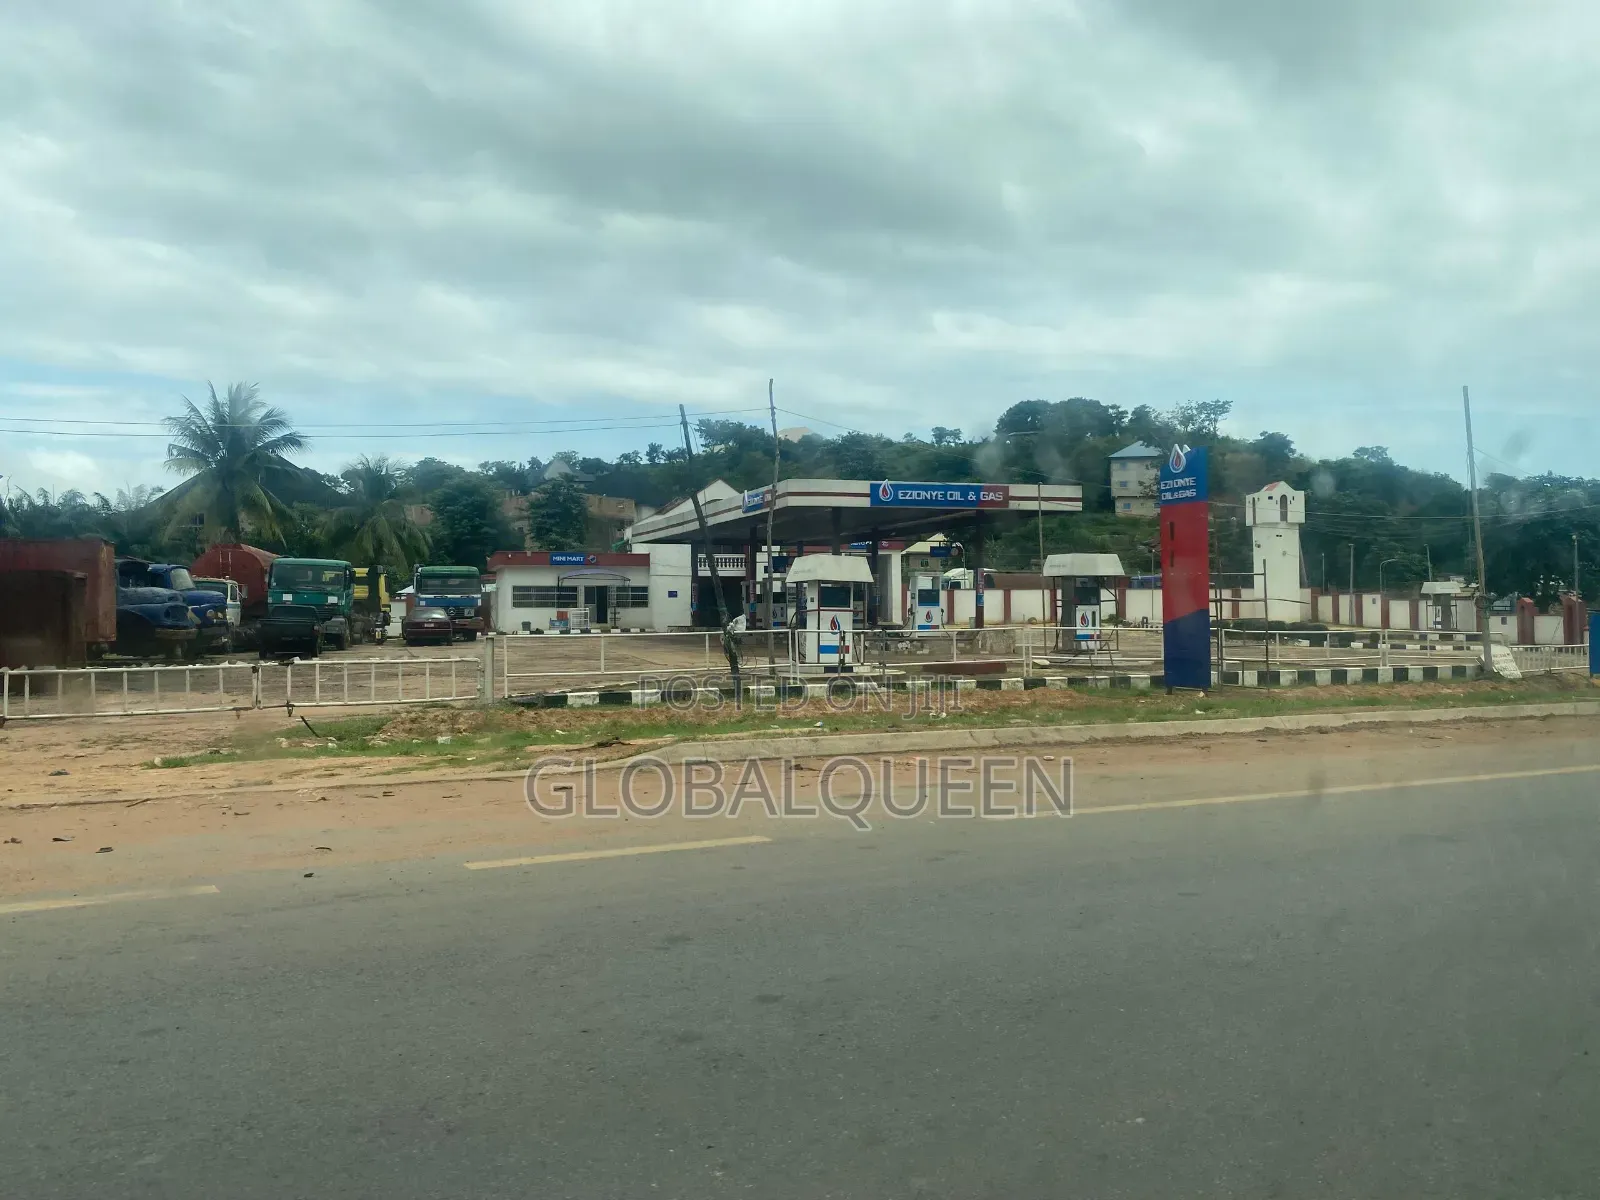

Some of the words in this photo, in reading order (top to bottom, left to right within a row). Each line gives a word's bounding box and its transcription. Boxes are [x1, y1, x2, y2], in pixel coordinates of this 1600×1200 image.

[898, 490, 944, 501] EZIONYE
[947, 491, 965, 501] OIL
[967, 491, 977, 501] &
[980, 491, 1003, 501] GAS
